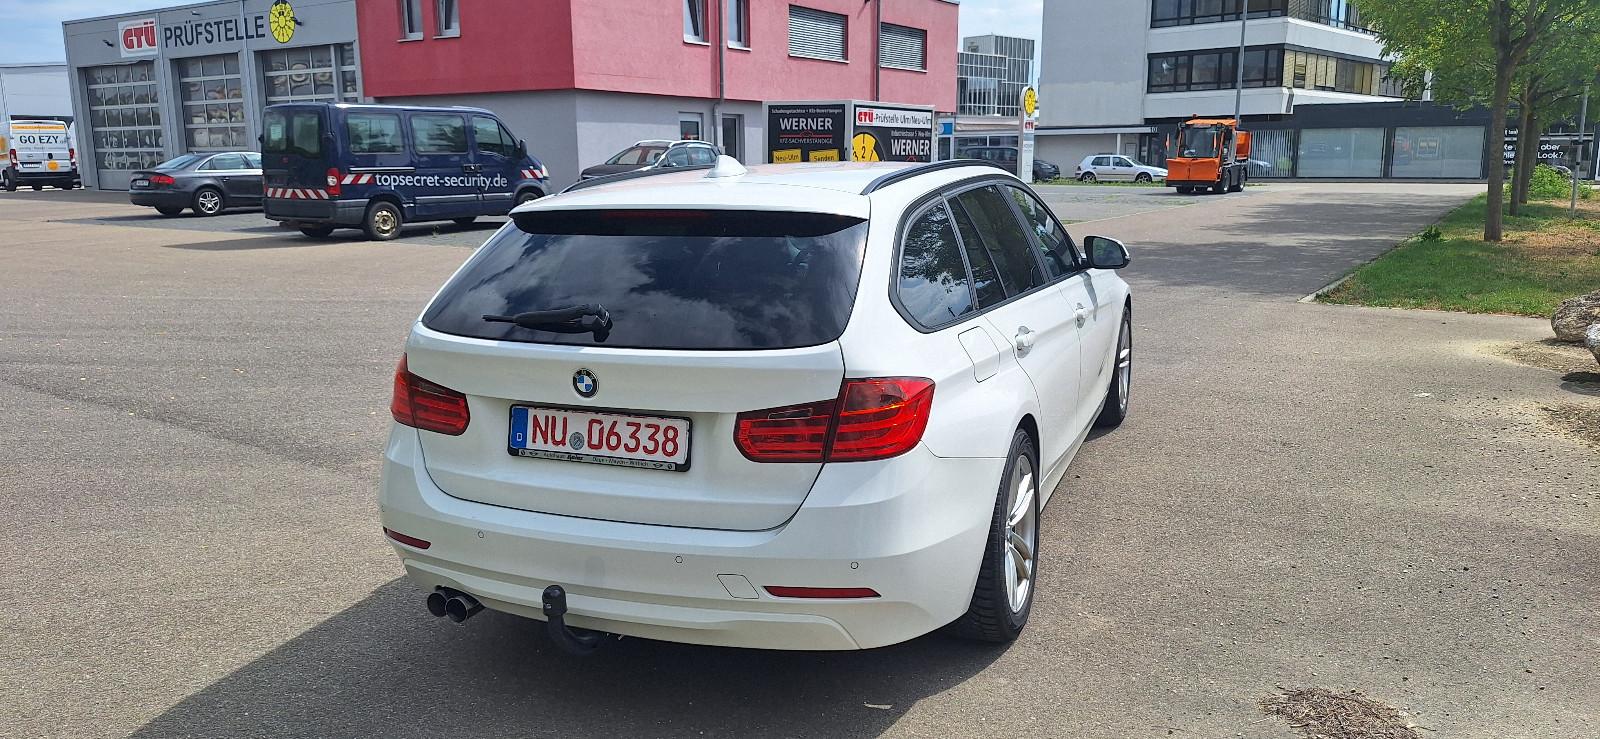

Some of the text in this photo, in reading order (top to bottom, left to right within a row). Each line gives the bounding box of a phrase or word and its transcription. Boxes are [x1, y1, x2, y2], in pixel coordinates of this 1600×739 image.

[122, 15, 266, 50] GTÜ PRÜFSTELLE
[779, 117, 833, 130] WERNER
[19, 135, 36, 144] GO
[38, 135, 59, 144] EZY
[890, 138, 931, 156] WERNER
[1537, 151, 1564, 159] Look?
[375, 173, 508, 191] topsecret-security.de
[516, 432, 523, 442] D
[531, 414, 679, 458] NU 06338
